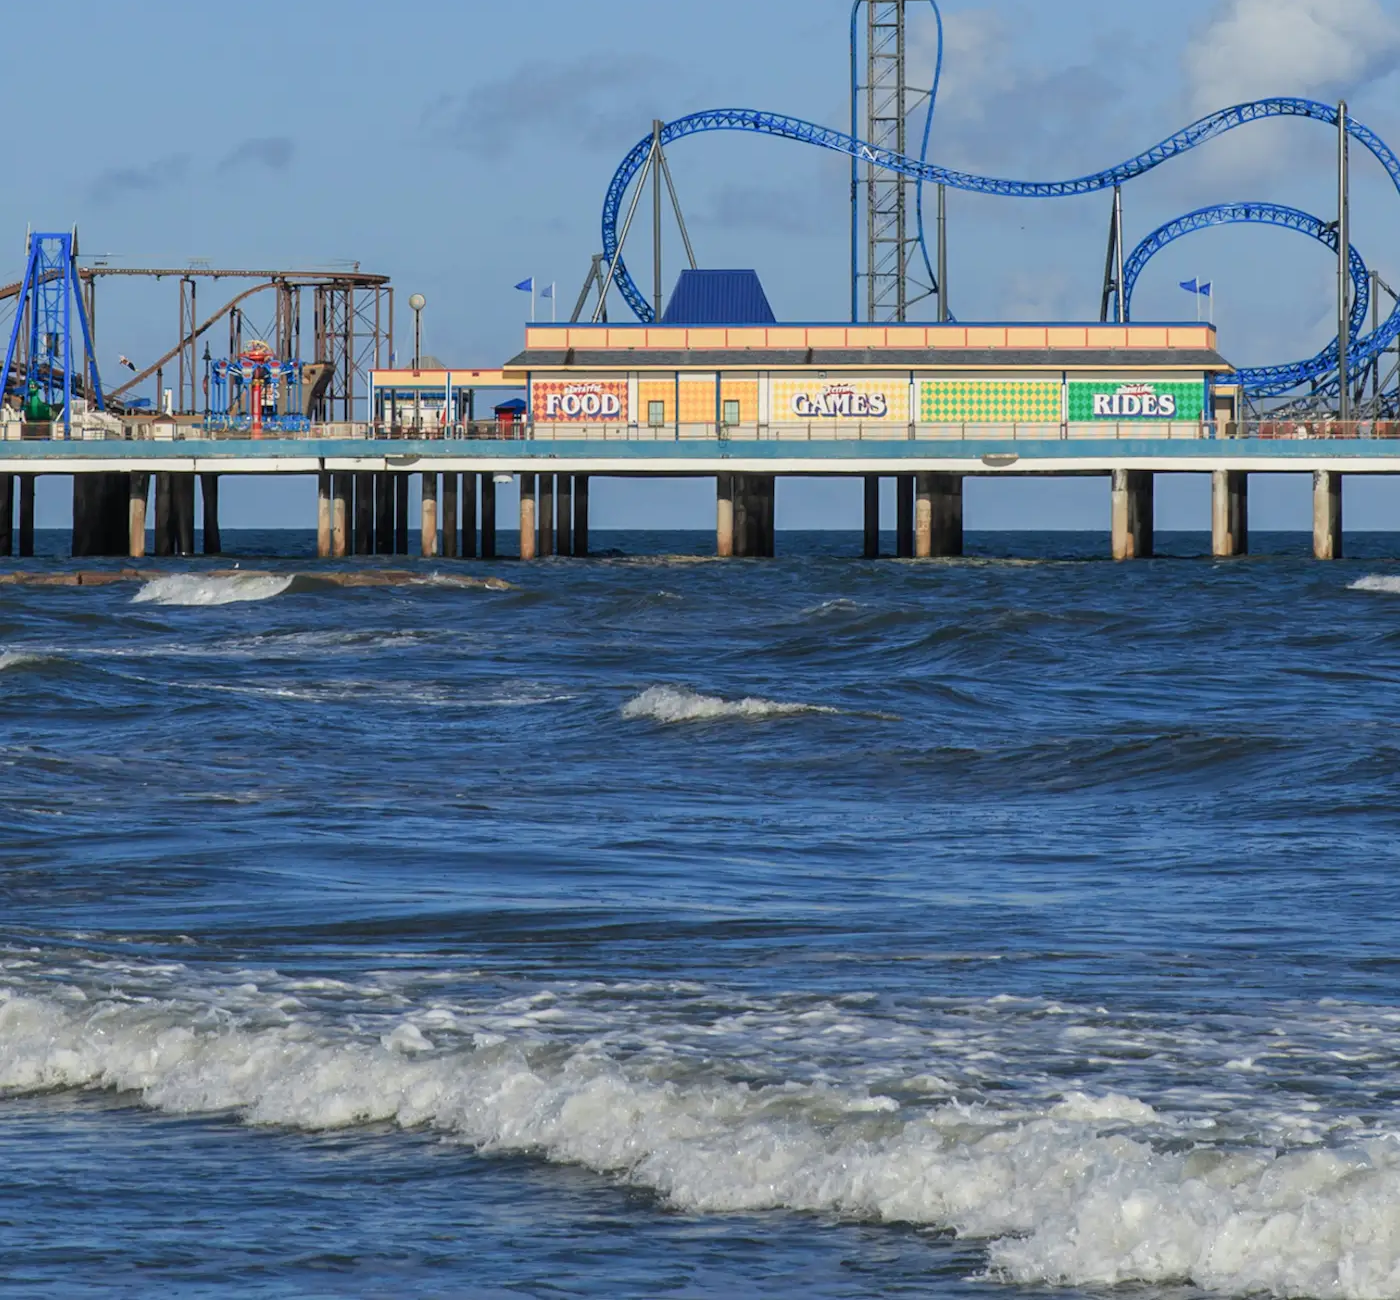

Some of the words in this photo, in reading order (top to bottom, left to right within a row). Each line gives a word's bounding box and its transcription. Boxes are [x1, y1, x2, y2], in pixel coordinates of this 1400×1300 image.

[546, 393, 620, 416] FOOD
[791, 393, 887, 416] GAMES
[1093, 393, 1176, 416] RIDES
